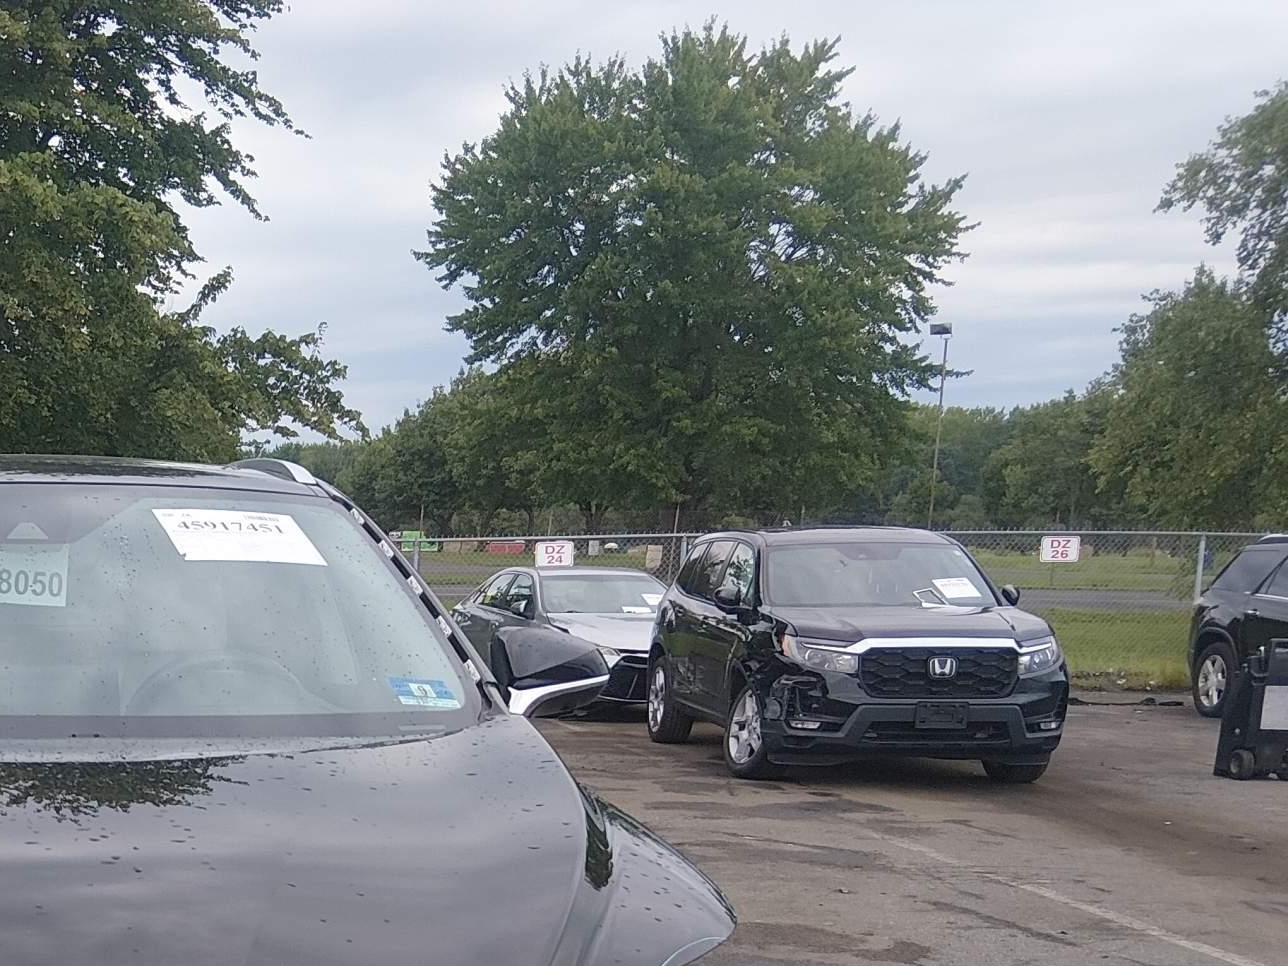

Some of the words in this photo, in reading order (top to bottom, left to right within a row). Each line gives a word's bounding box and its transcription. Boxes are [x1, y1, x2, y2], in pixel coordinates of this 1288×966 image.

[177, 520, 284, 534] 45917451
[1050, 539, 1072, 549] DZ
[544, 545, 566, 554] DZ
[1051, 549, 1069, 559] 26
[546, 555, 563, 564] 24
